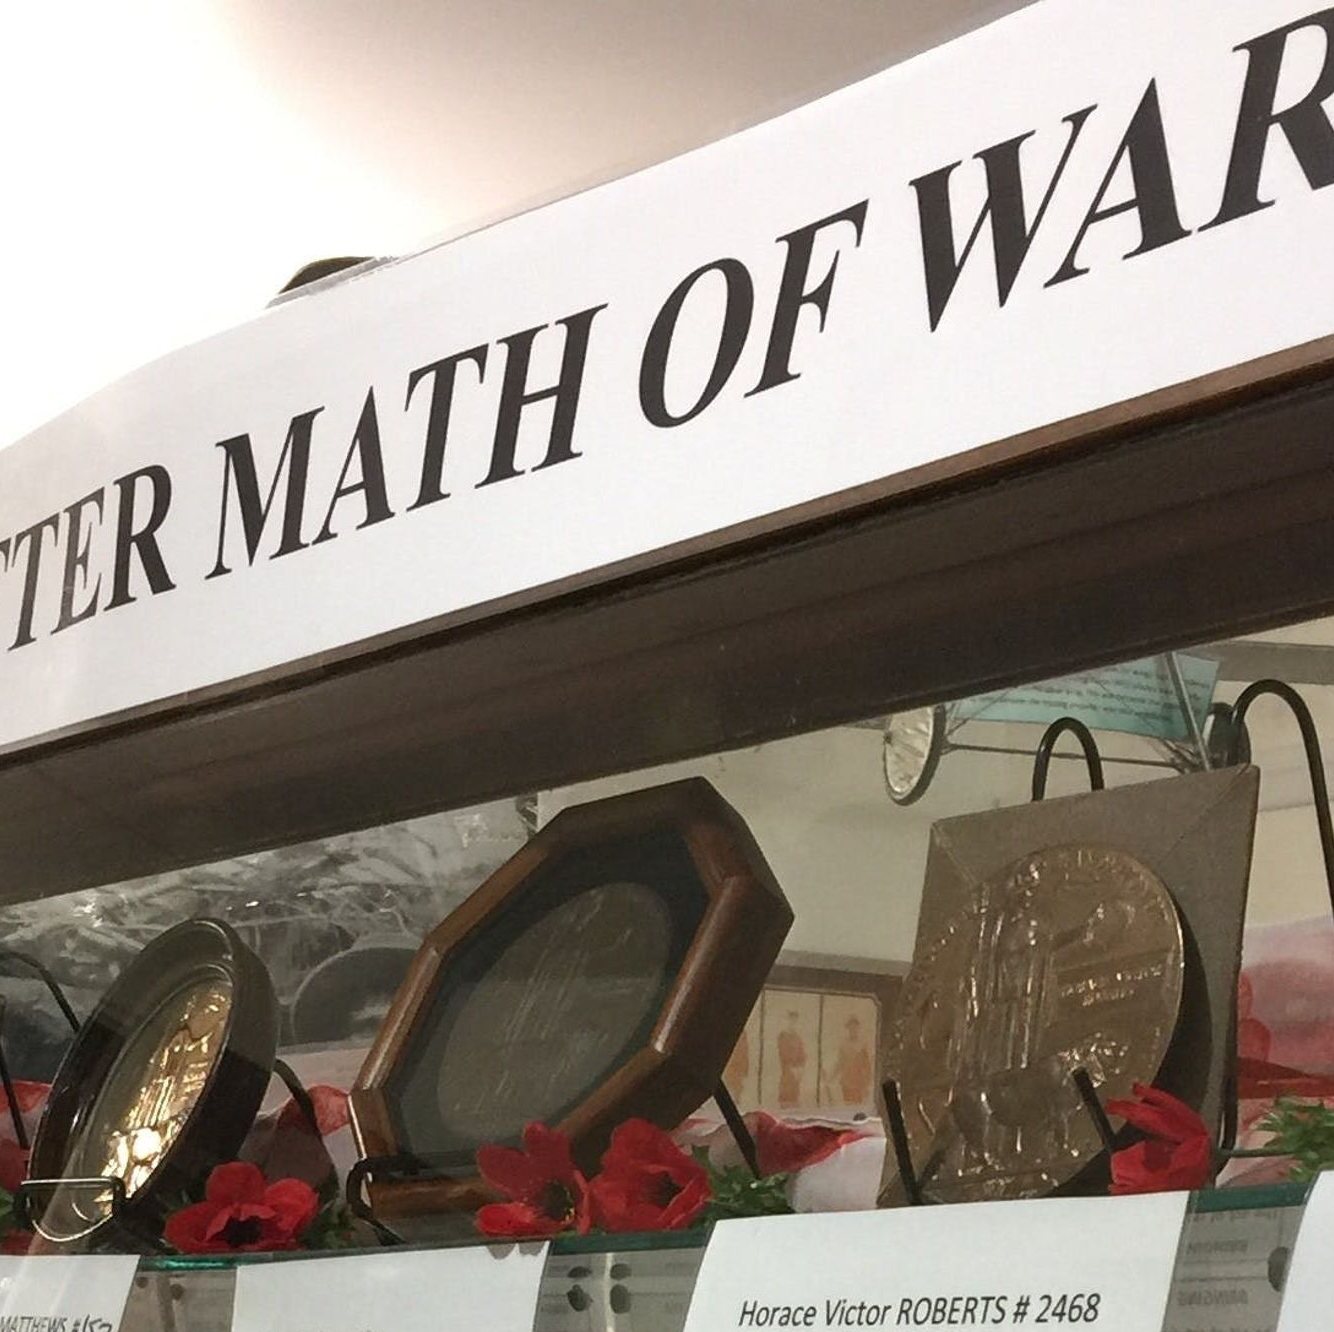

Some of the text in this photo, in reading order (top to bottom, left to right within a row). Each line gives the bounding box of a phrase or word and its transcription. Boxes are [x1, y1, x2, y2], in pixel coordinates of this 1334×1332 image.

[206, 304, 607, 579] MATH
[640, 200, 868, 427] OF
[739, 1293, 1101, 1327] Horace Victor ROBERTS # 2468
